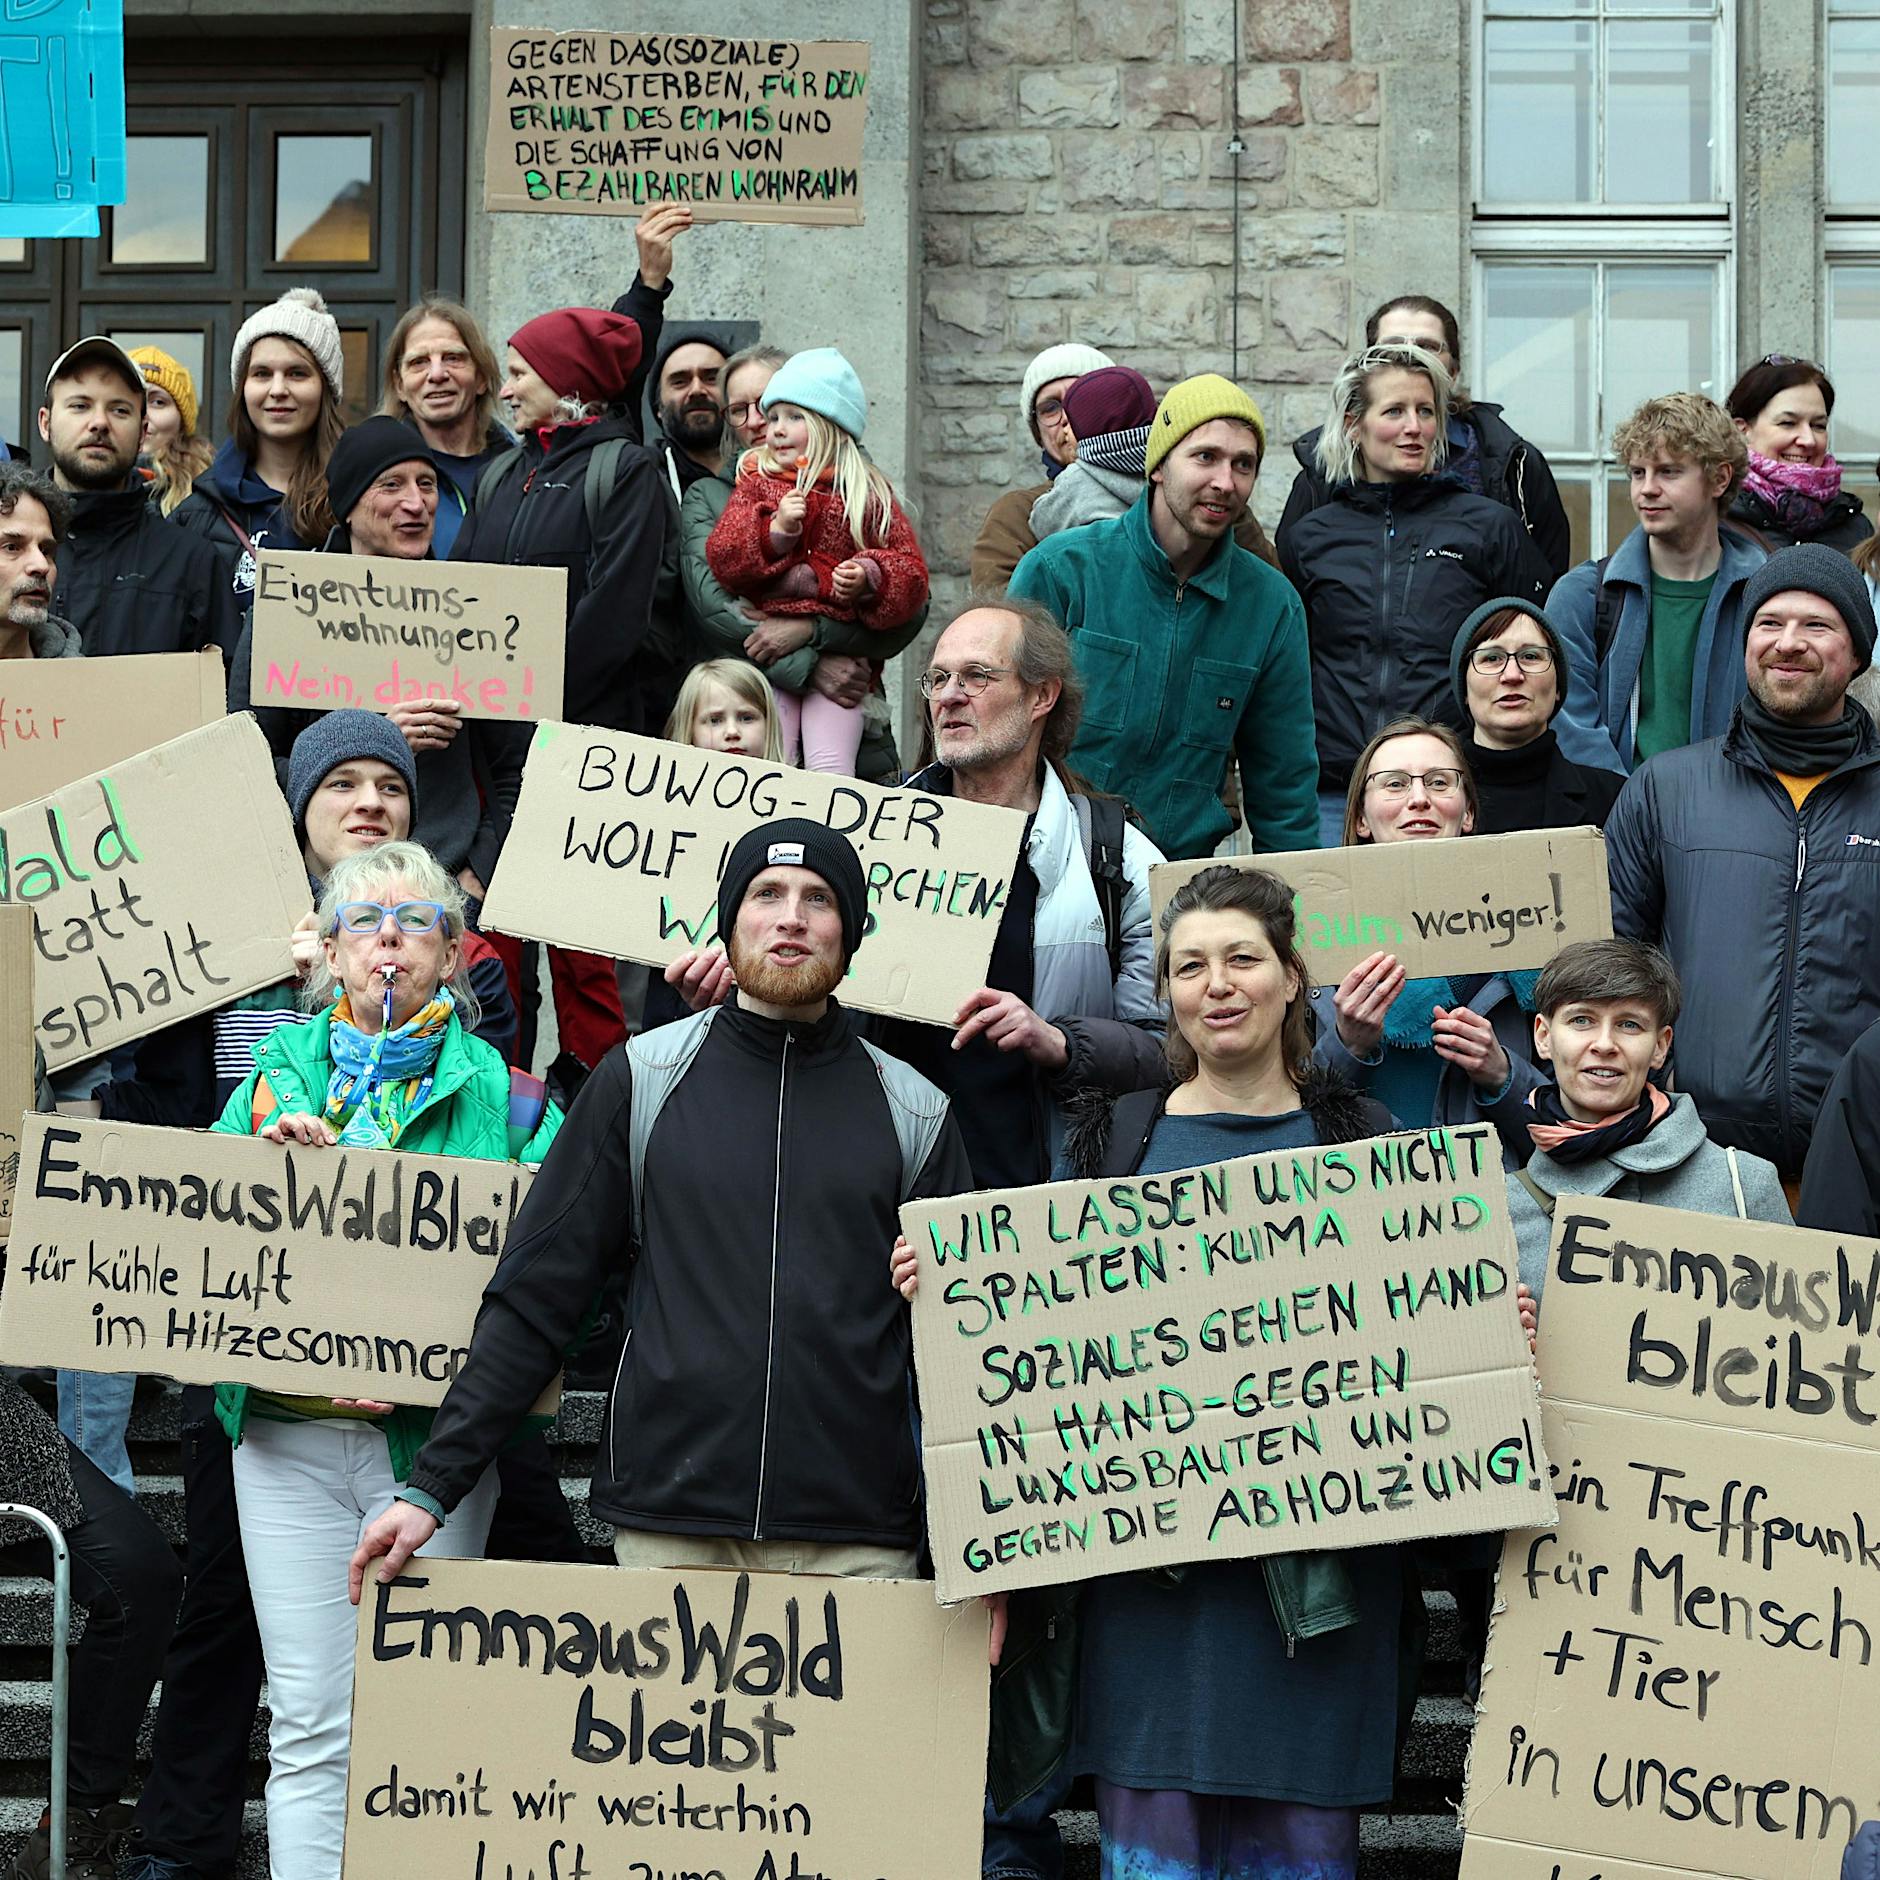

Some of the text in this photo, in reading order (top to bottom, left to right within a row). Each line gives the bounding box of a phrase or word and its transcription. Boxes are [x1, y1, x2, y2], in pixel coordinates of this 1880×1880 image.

[506, 69, 868, 103] ARTENSTERBEN, FÜR DEN
[507, 39, 597, 69] GEGEN
[510, 104, 831, 135] ERHALT DES EMMIS UND
[515, 137, 783, 166] DIE SCHAFFUNG VON
[524, 169, 857, 205] BEZAHLBAREN WOHNRAUM
[259, 562, 479, 618] Eigentums-
[317, 612, 520, 665] wohnungen?
[264, 658, 534, 716] Nein, danke!
[0, 776, 144, 902] ald
[563, 816, 697, 878] WOLF
[866, 861, 1007, 919] RCHEN-
[1292, 872, 1567, 950] aum weniger!
[36, 921, 231, 1048] sphalt
[928, 1128, 1490, 1267] WIR LASSEN UNS NICHT
[22, 1240, 293, 1311] für kühle Luft
[943, 1194, 1492, 1338] SPALTEN: KLIMA UND
[1556, 1214, 1880, 1336] EmmausW
[92, 1302, 147, 1350] im
[976, 1257, 1509, 1408] SOZIALES GEHEN HAND
[1626, 1307, 1879, 1426] bleibt
[977, 1412, 1028, 1469] IN
[978, 1403, 1452, 1515] LUXUSBAUTEN UND
[963, 1418, 1542, 1573] GEGEN DIE ABHOLZUNG!
[1627, 1461, 1880, 1572] Treffpunk
[1521, 1533, 1872, 1667] für Mensch
[571, 1684, 796, 1774] bleibt
[364, 1764, 812, 1836] damit wir weiterhin
[1507, 1724, 1857, 1842] in unserem
